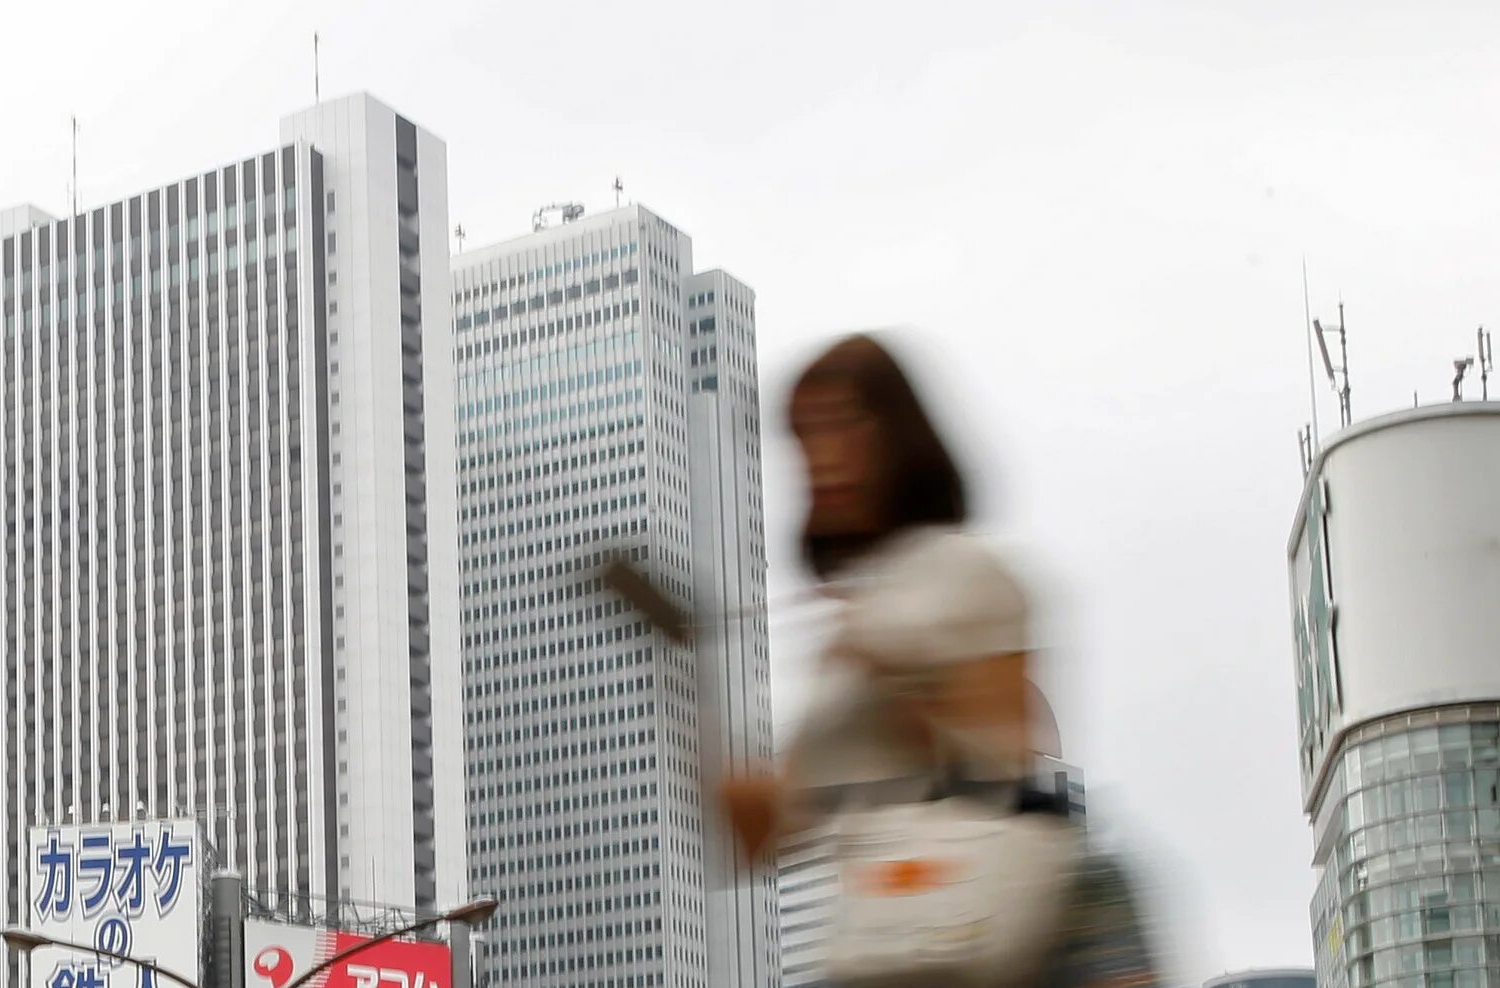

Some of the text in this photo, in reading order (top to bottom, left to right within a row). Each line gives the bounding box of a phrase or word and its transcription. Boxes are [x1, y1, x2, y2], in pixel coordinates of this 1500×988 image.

[36, 829, 193, 921] カラオケ
[95, 914, 131, 967] の
